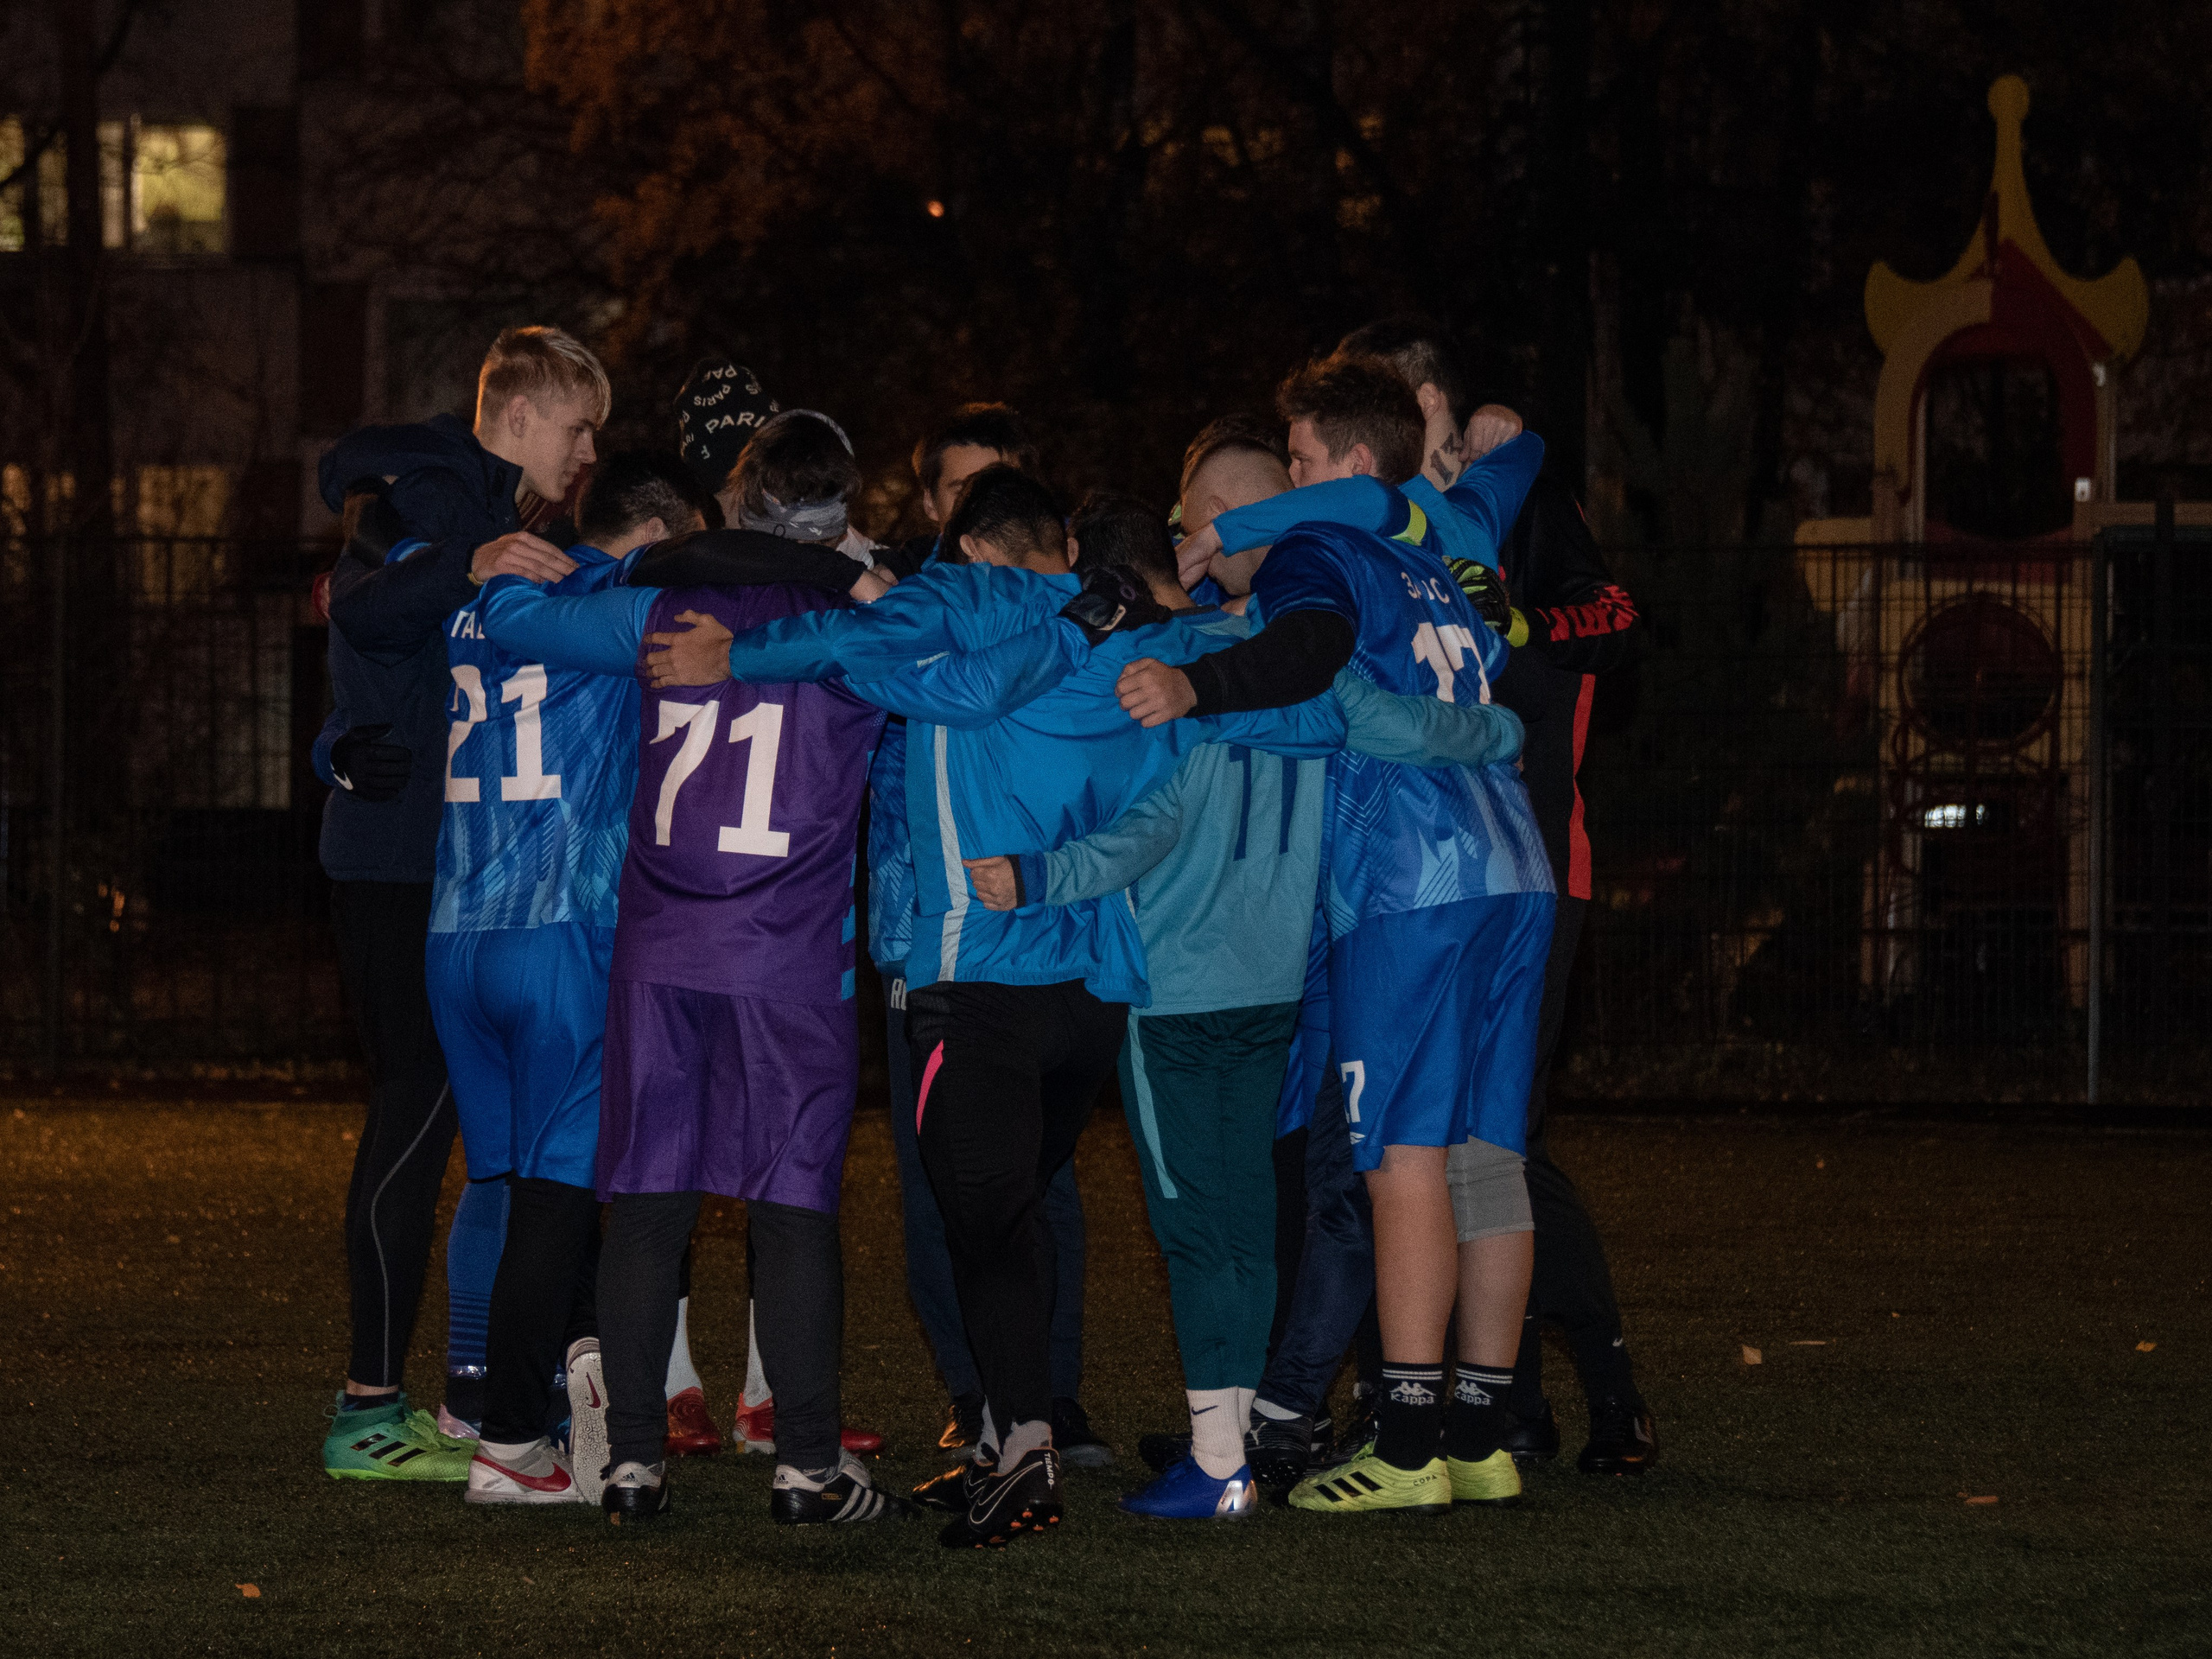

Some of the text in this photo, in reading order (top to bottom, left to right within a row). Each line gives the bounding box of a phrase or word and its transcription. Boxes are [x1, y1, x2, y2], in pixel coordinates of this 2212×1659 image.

[693, 384, 731, 407] PARIS
[1411, 621, 1491, 705] 17
[444, 664, 562, 803] 21
[650, 700, 790, 858] 71
[1340, 1060, 1365, 1123] 7
[1390, 1392, 1435, 1406] Kappa
[1044, 1452, 1054, 1487] TIEMPO
[1413, 1474, 1438, 1486] COPA
